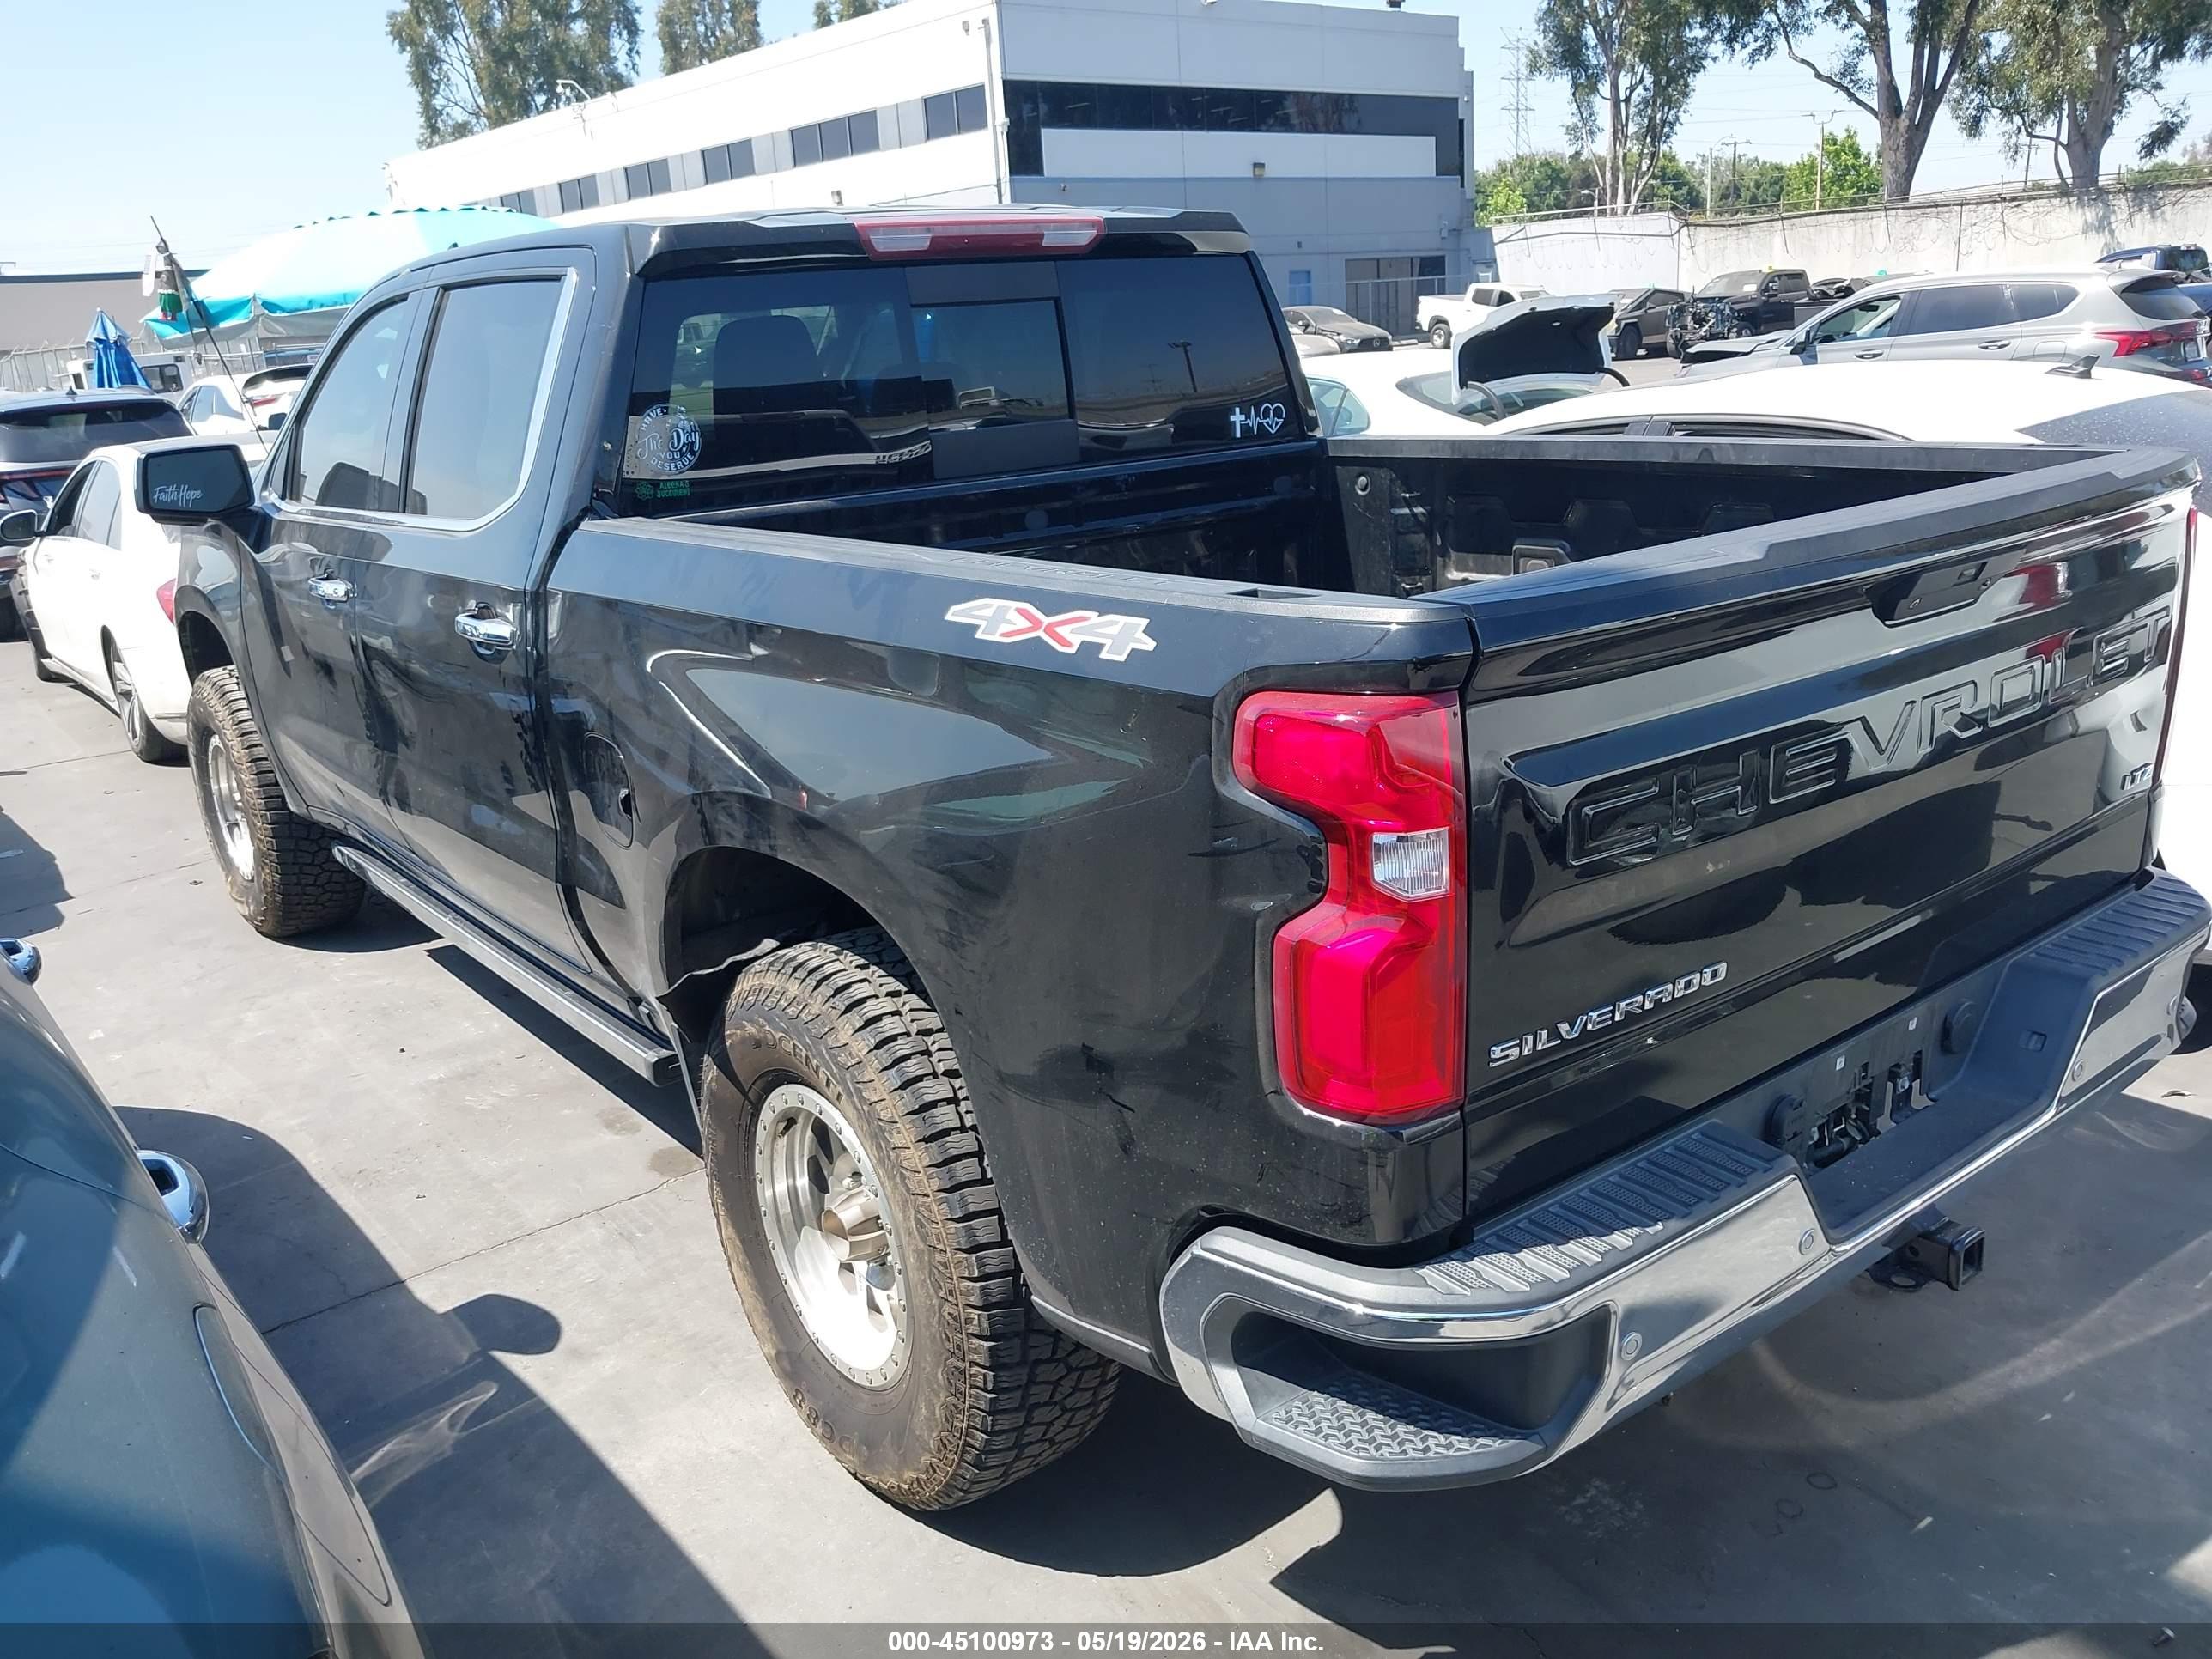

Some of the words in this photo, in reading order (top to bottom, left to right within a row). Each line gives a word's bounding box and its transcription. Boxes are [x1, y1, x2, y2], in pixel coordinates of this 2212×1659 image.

[641, 408, 663, 431] HAVE
[637, 433, 663, 459] The
[669, 428, 700, 451] Day
[659, 451, 681, 459] YOU
[153, 484, 178, 504] Faith
[179, 484, 203, 508] Hope
[1567, 605, 2171, 867] CHEVROLET
[2120, 763, 2153, 790] LTZ
[1488, 961, 1728, 1067] SILVERADO
